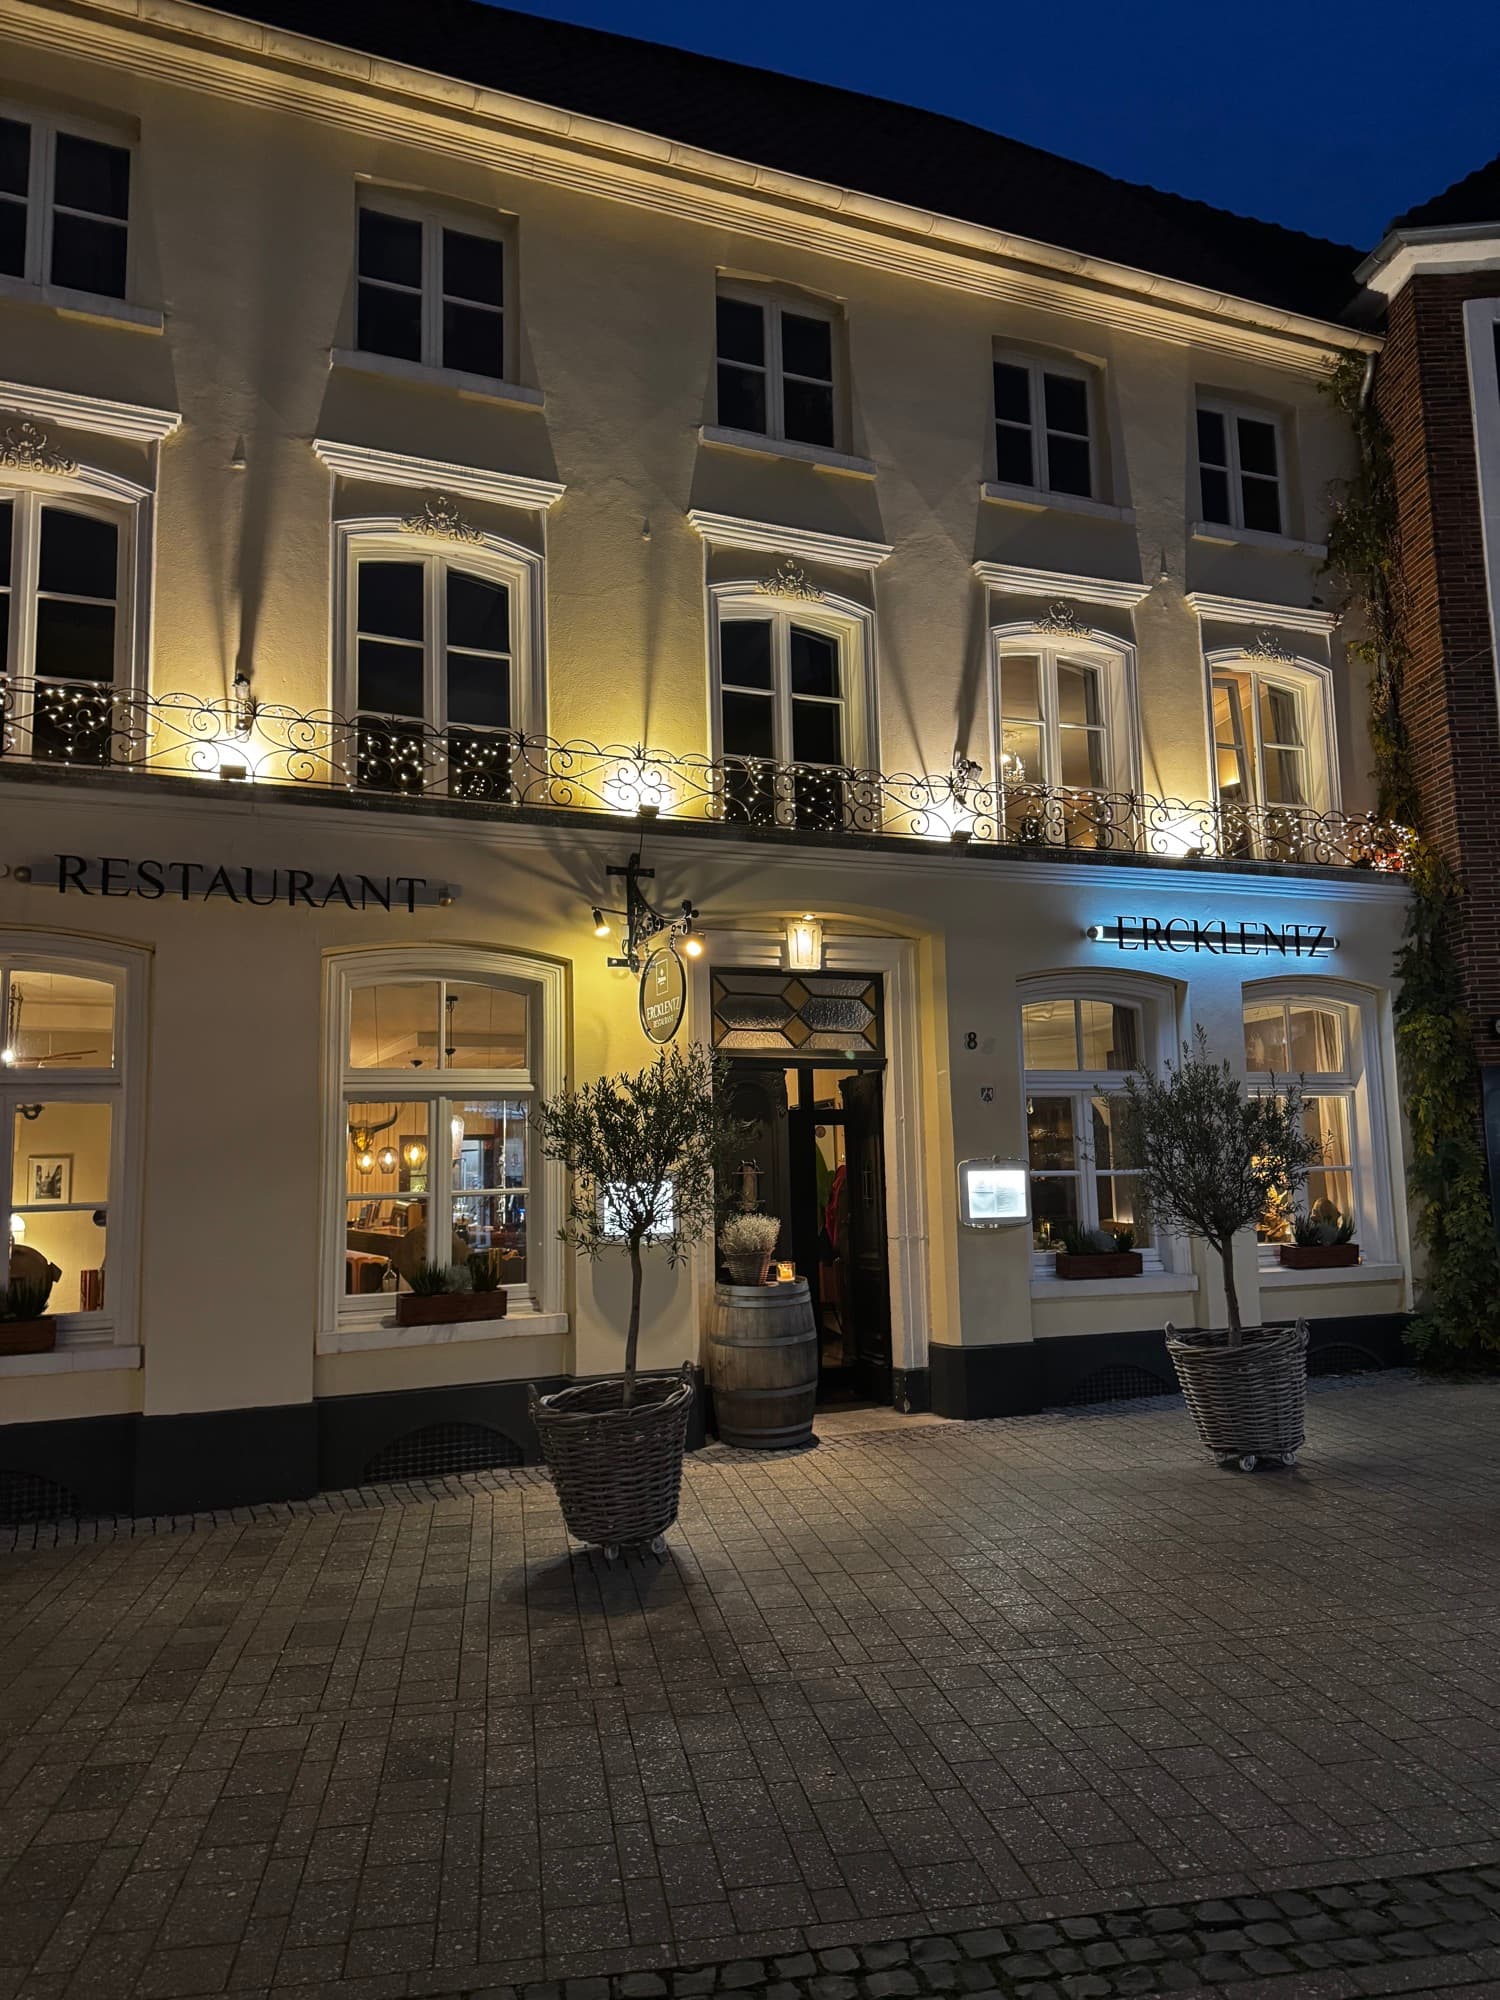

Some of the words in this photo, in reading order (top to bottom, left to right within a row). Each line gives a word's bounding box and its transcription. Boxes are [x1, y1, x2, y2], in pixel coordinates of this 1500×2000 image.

[53, 853, 428, 913] RESTAURANT
[1113, 915, 1329, 958] ERCKLENTZ
[967, 1031, 978, 1050] 8
